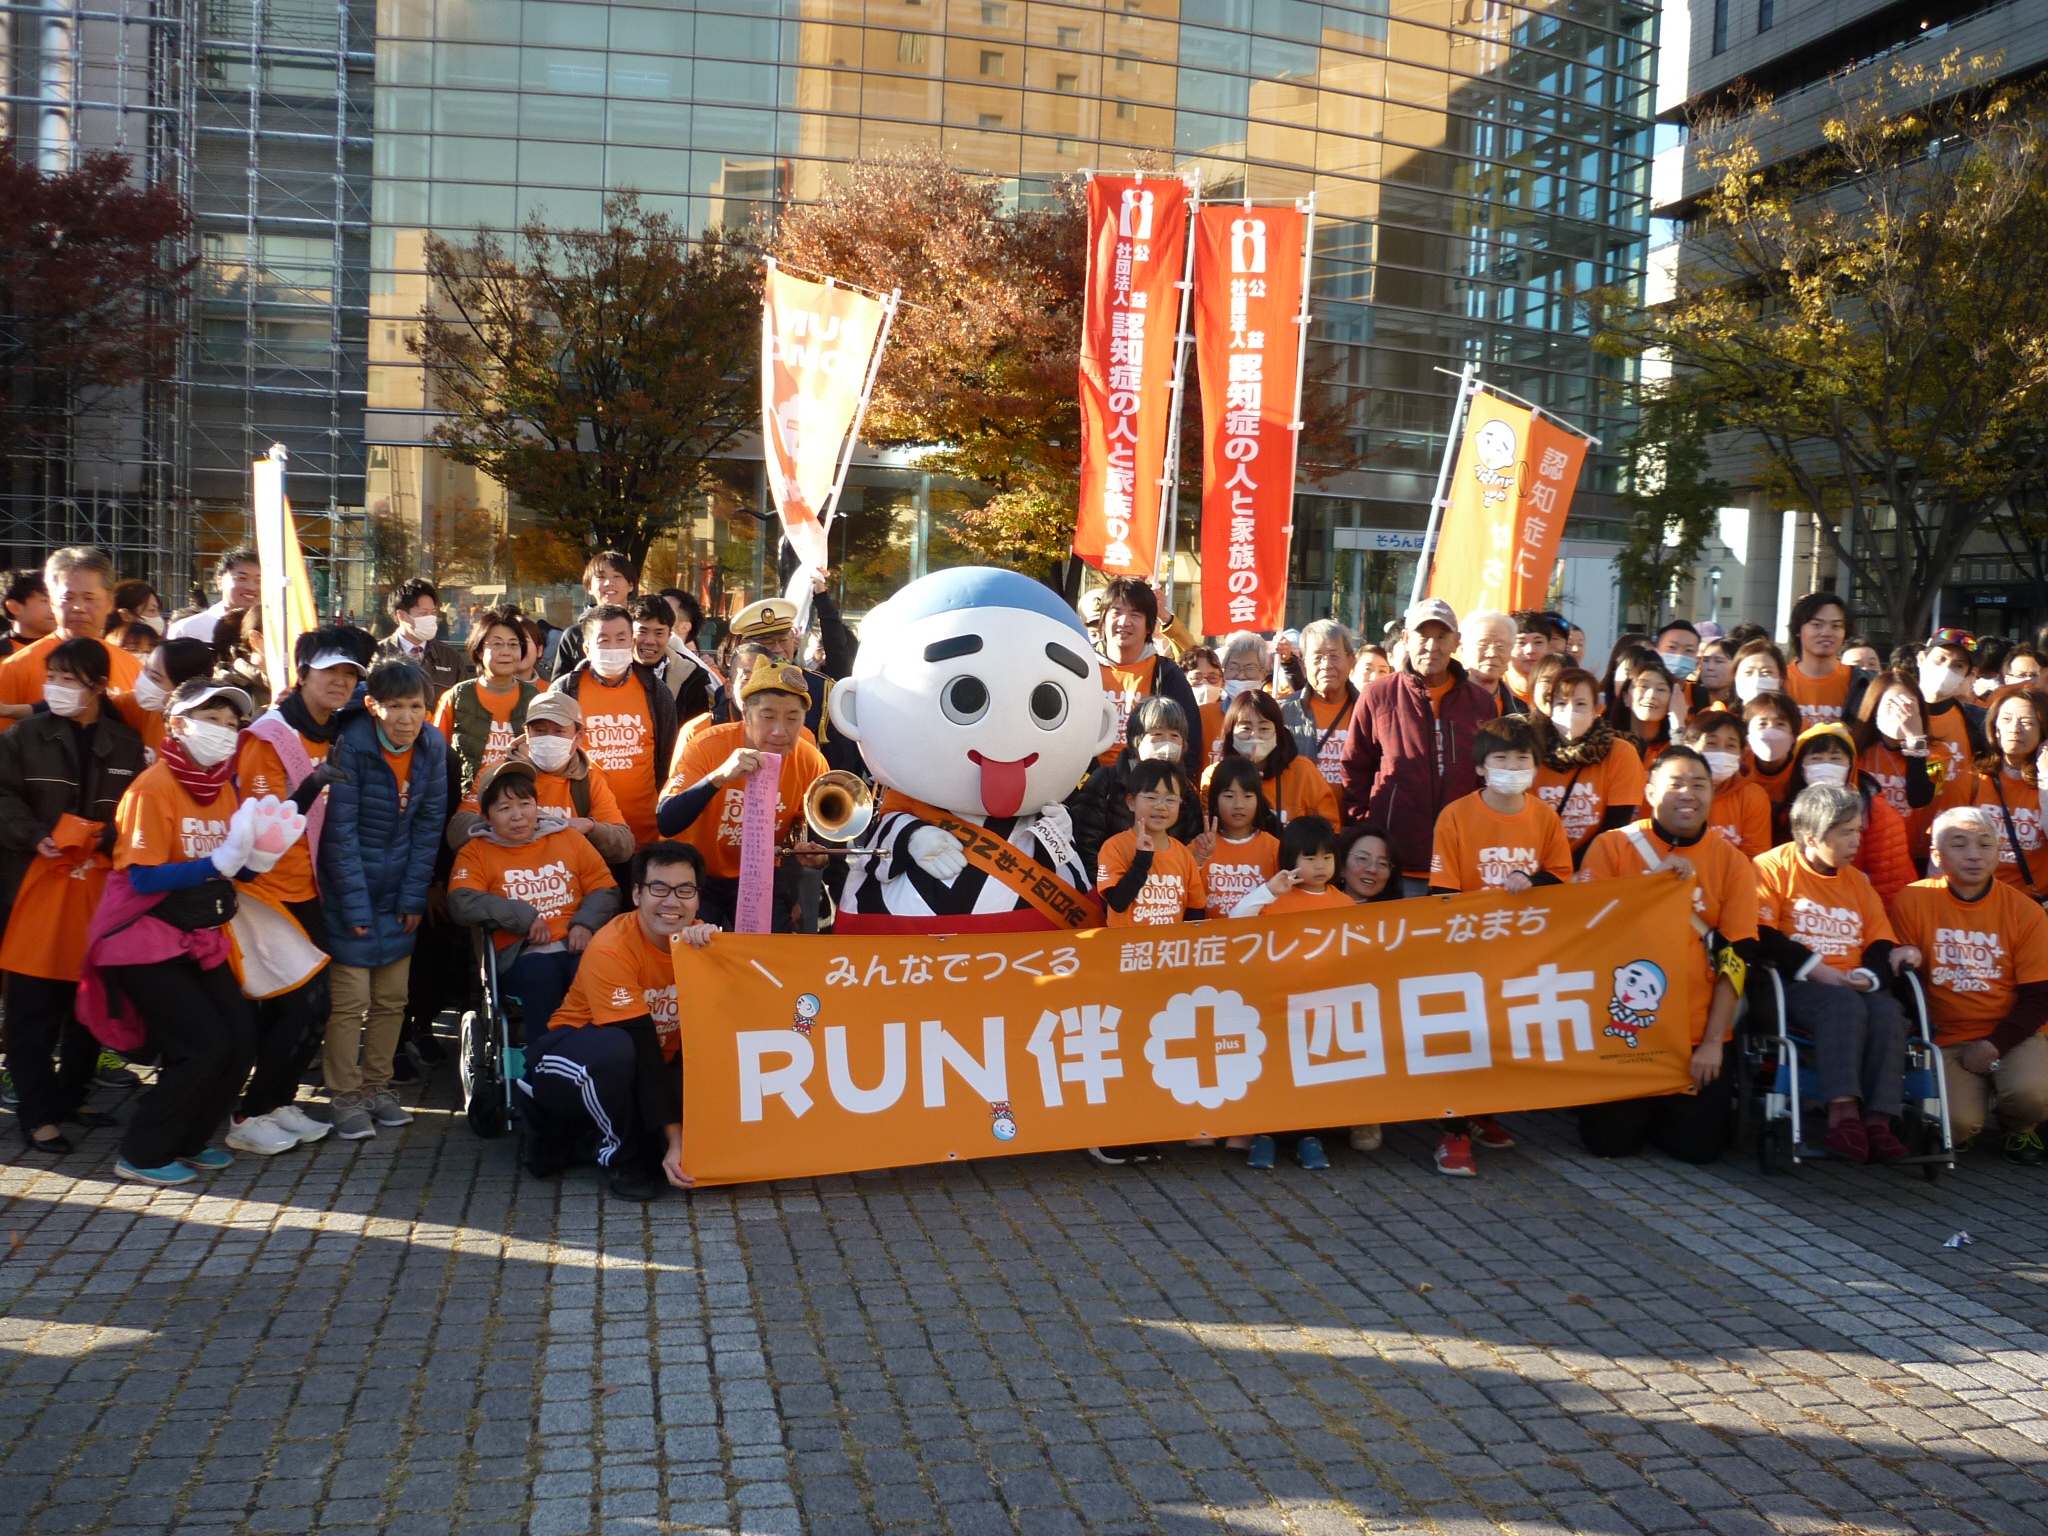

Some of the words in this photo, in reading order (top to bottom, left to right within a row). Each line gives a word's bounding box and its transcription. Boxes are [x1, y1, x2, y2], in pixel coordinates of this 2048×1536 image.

[1113, 243, 1132, 307] 社団法人
[1103, 312, 1146, 567] 認知症の人と家族の会
[1224, 354, 1263, 623] 認知症の人と家族の会
[1514, 447, 1569, 579] 認知症に
[586, 714, 641, 728] RUN
[603, 758, 633, 770] 2023
[1479, 846, 1536, 863] RUN
[504, 860, 566, 883] RUN
[1209, 863, 1260, 876] RUN
[1794, 898, 1860, 923] RUN
[824, 946, 1080, 987] みんなでつくる
[1120, 906, 1551, 972] 認知症フレンドリーなまち
[1936, 928, 1997, 947] RUN
[1287, 963, 1595, 1087] 四日市
[1215, 1037, 1240, 1052] plus
